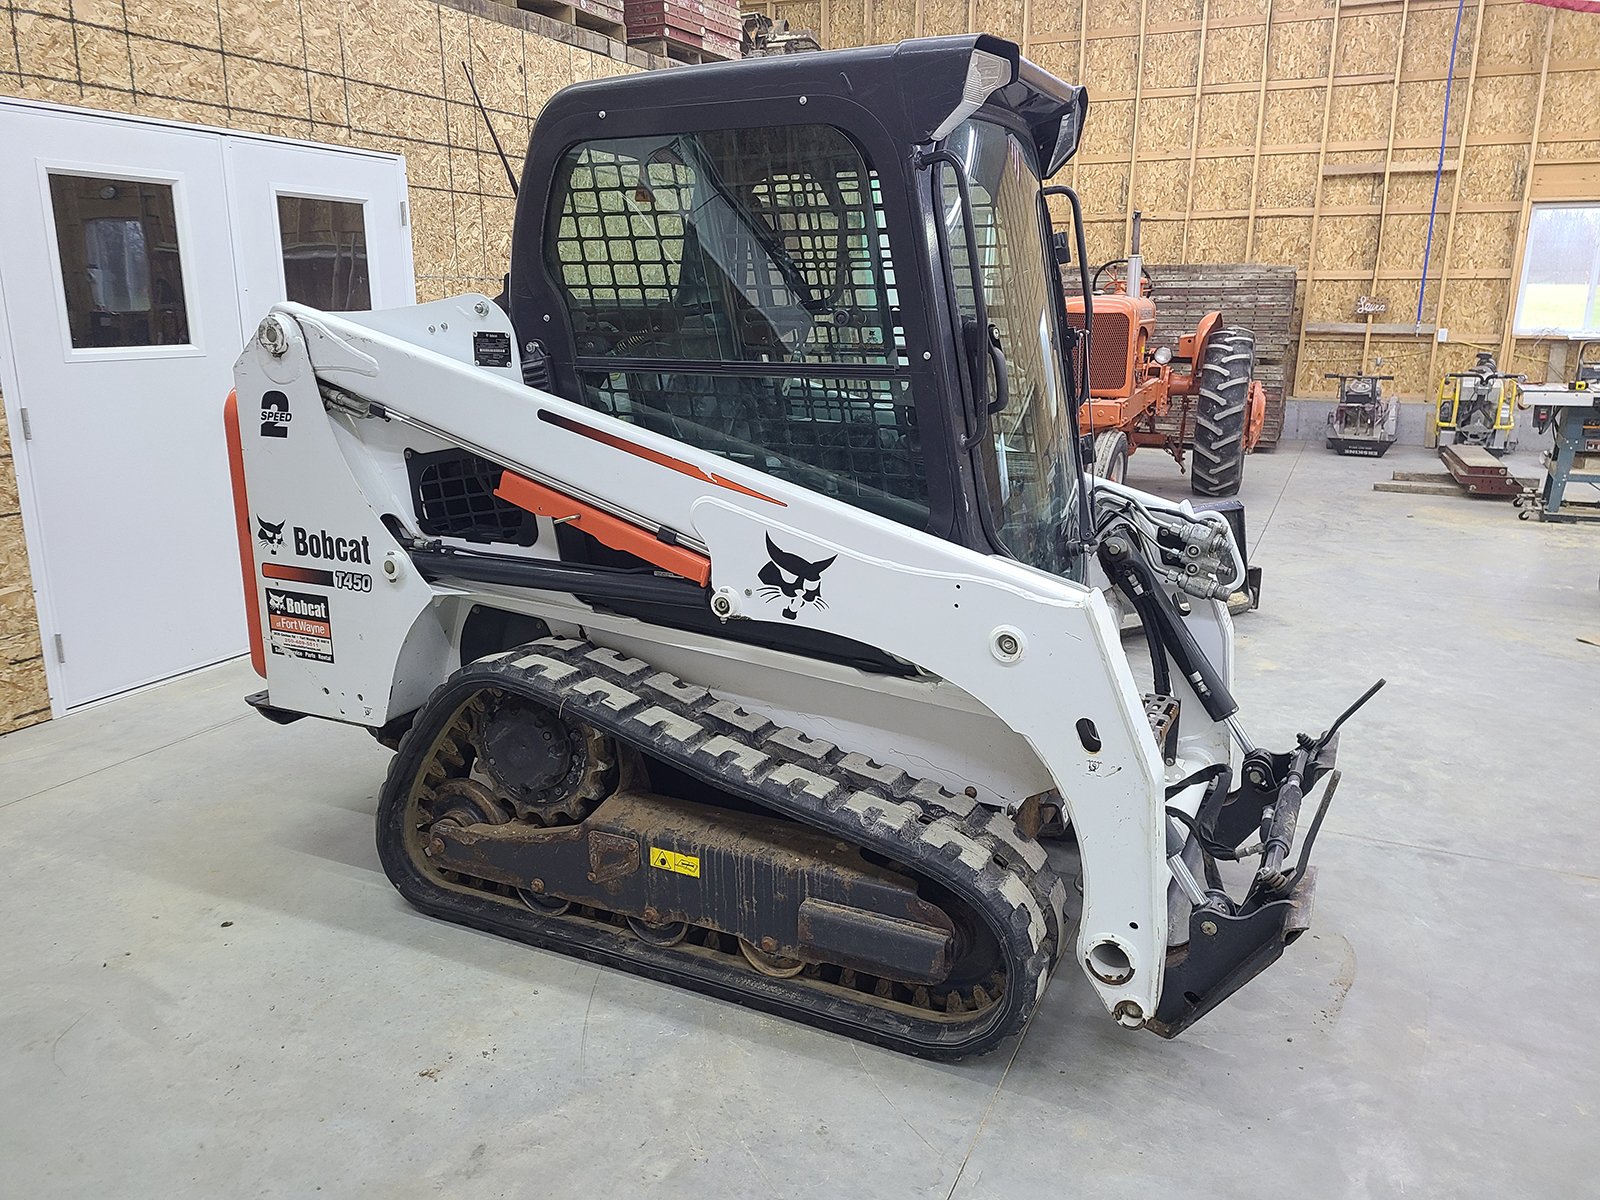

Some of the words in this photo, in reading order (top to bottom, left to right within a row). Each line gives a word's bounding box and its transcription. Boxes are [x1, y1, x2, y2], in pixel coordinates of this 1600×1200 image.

[260, 411, 292, 422] SPEED
[261, 390, 289, 438] 2
[293, 526, 371, 565] Bobcat
[335, 570, 373, 593] T450
[286, 597, 327, 619] Bobcat
[281, 617, 297, 631] Fort
[298, 620, 325, 635] Wayne
